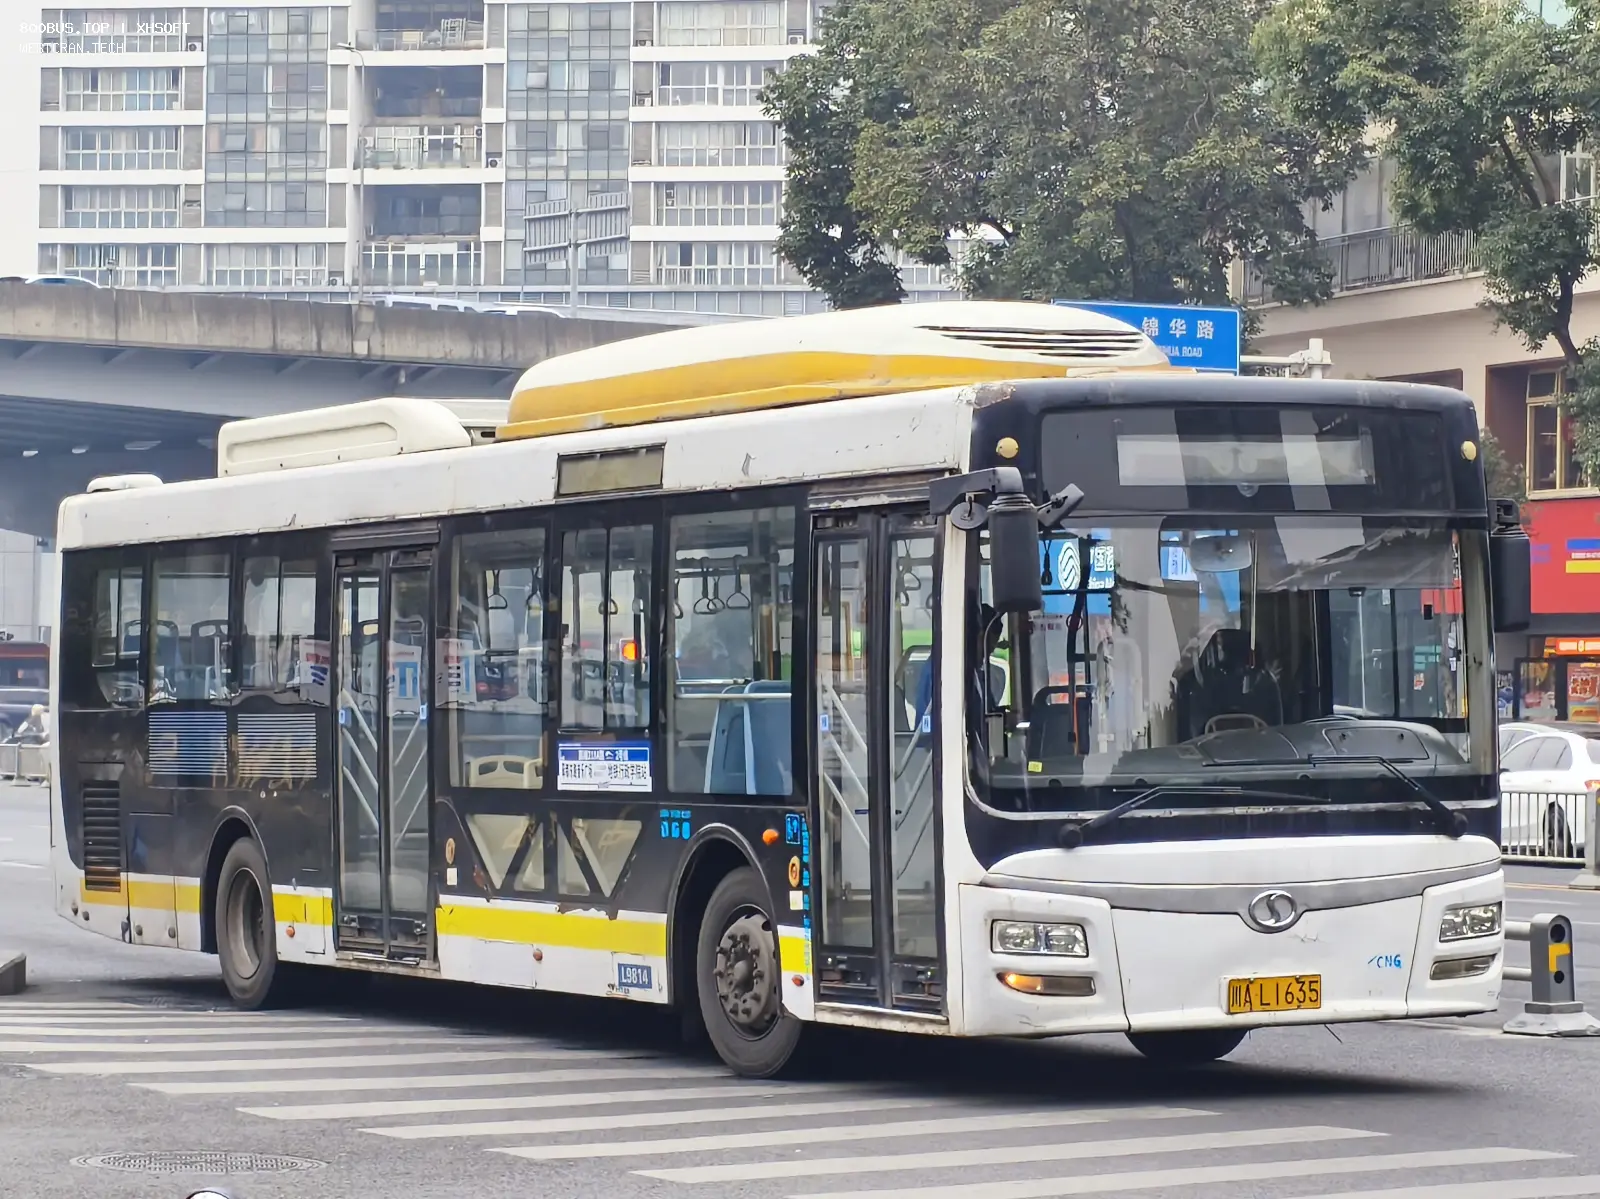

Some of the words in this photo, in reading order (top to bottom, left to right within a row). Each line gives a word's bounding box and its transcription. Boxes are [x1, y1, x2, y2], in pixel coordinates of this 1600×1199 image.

[1141, 316, 1215, 340] 锦华路
[1182, 346, 1203, 358] ROAD
[1376, 953, 1403, 969] CNG
[621, 965, 649, 985] L9814
